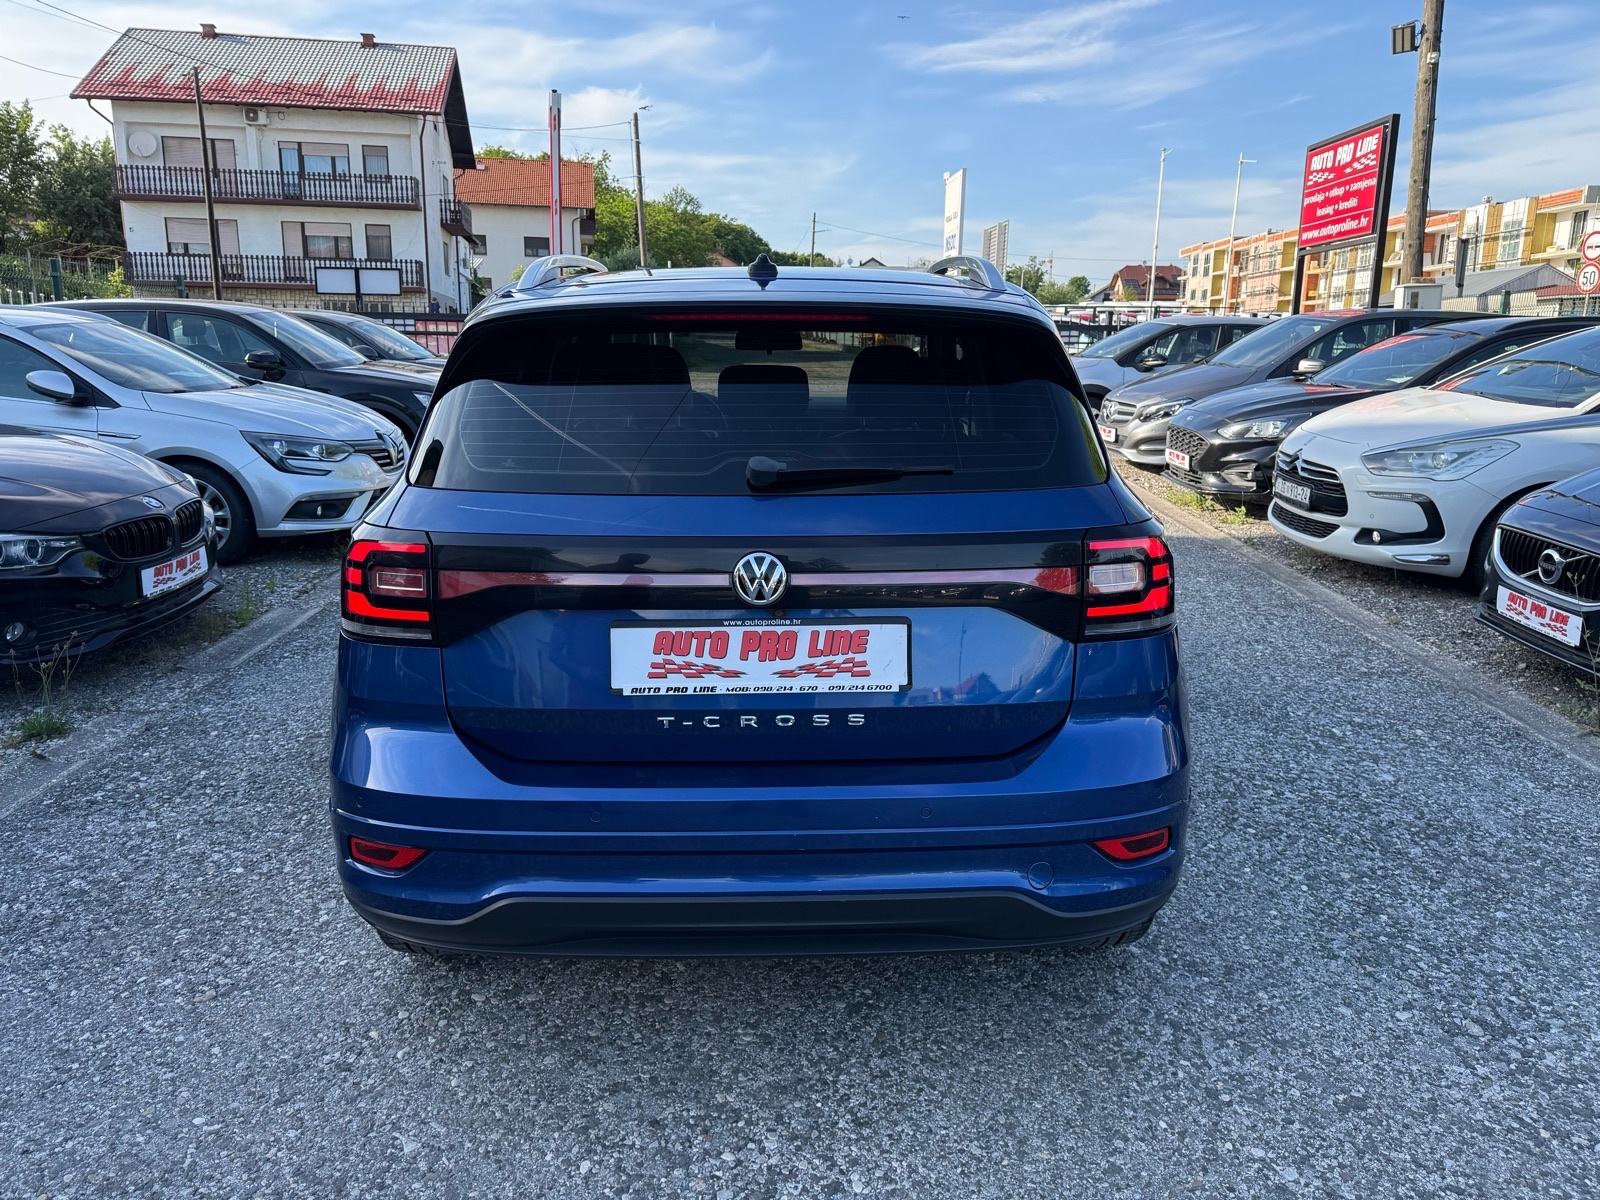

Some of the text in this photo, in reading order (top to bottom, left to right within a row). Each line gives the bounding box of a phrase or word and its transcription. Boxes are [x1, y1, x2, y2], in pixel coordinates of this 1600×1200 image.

[1310, 133, 1380, 171] AUTO PRO LINE
[1304, 177, 1376, 207] prodaja otkup zamjena
[1316, 196, 1358, 217] leasing krediti
[1302, 215, 1369, 240] www.autoproline.hr
[1582, 270, 1596, 286] 50
[153, 562, 174, 578] AUTO
[175, 557, 188, 573] PRO
[1507, 591, 1528, 611] AUTO
[1529, 601, 1548, 620] PRO
[1549, 609, 1571, 626] LINE
[722, 618, 801, 627] www.autoproline.hr
[652, 628, 870, 662] AUTO PRO LINE
[630, 686, 661, 695] AUTO
[665, 686, 689, 694] PRO
[692, 685, 718, 694] LINE
[656, 713, 866, 729] T-CROSS
